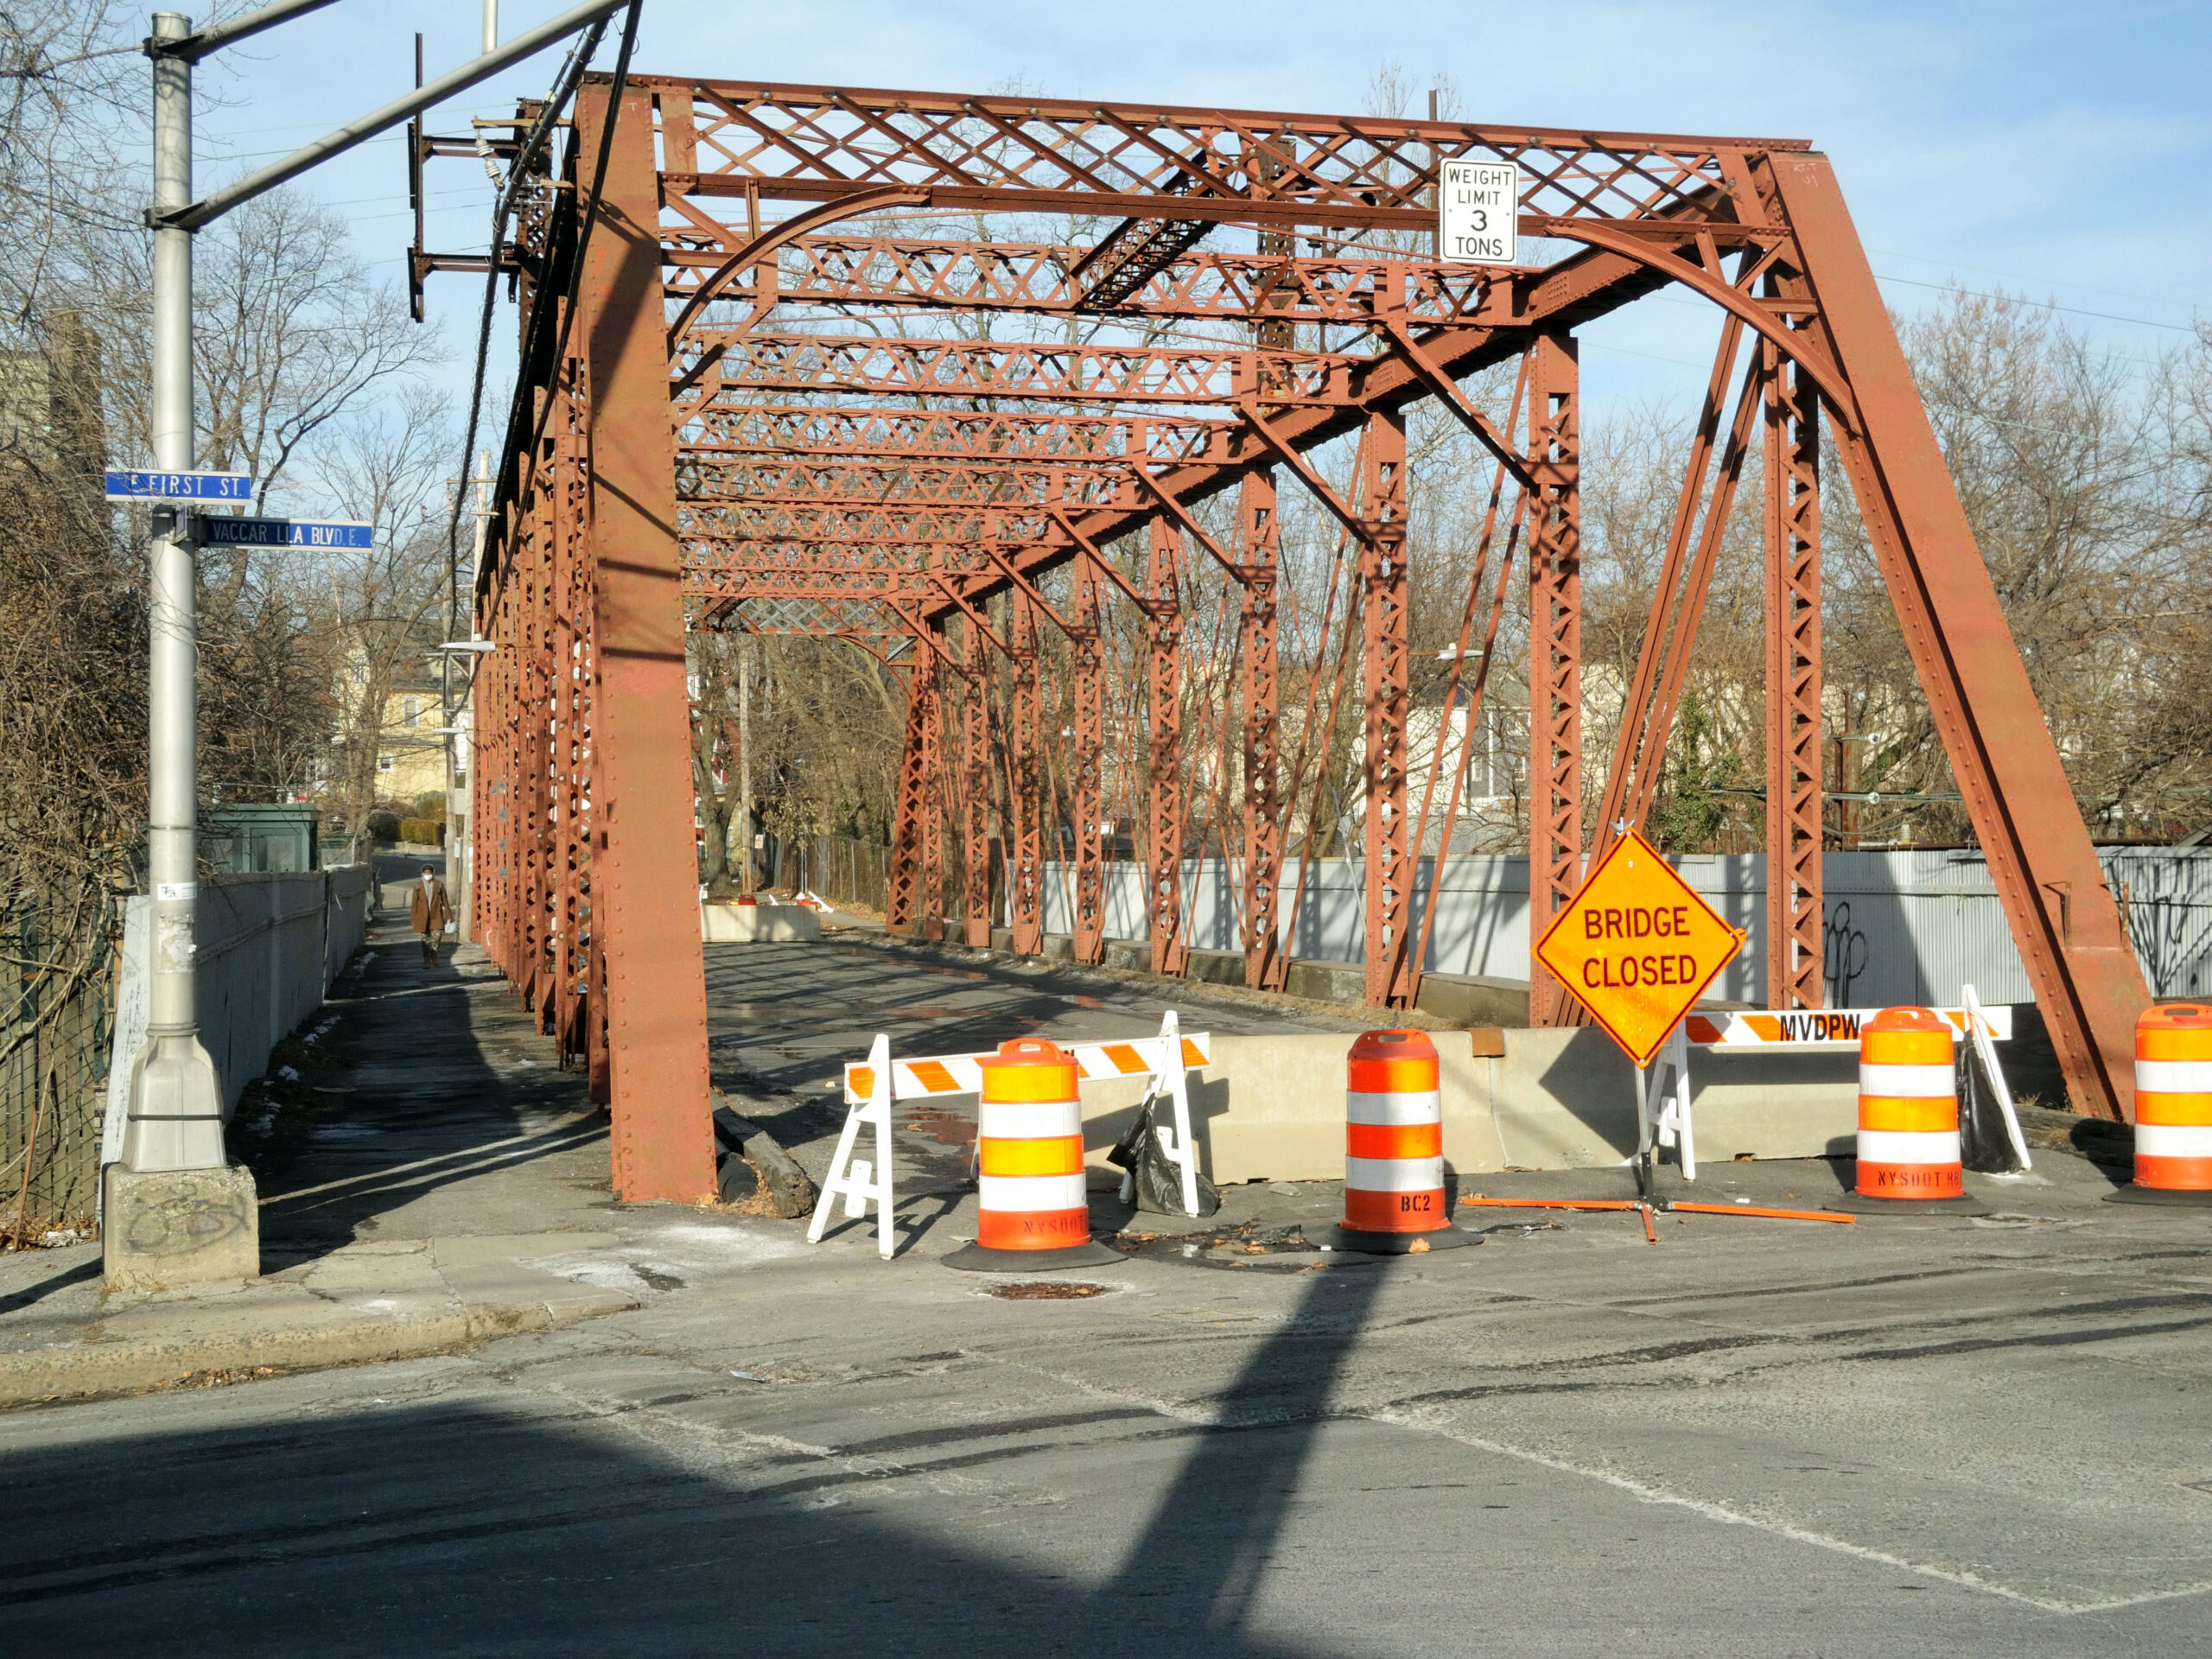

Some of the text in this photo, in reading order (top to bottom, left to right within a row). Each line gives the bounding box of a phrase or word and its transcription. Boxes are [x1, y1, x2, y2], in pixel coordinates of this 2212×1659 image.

[1449, 168, 1511, 186] WEIGHT
[1458, 189, 1501, 205] LIMIT
[1471, 209, 1487, 232] 3
[1455, 236, 1503, 257] TONS
[149, 474, 204, 496] FIRST
[1584, 906, 1691, 939] BRIDGE
[1582, 954, 1697, 988] CLOSED
[1780, 1014, 1860, 1041] MVDPW
[1878, 1170, 1941, 1187] NYSDOT
[1402, 1194, 1430, 1211] BC2
